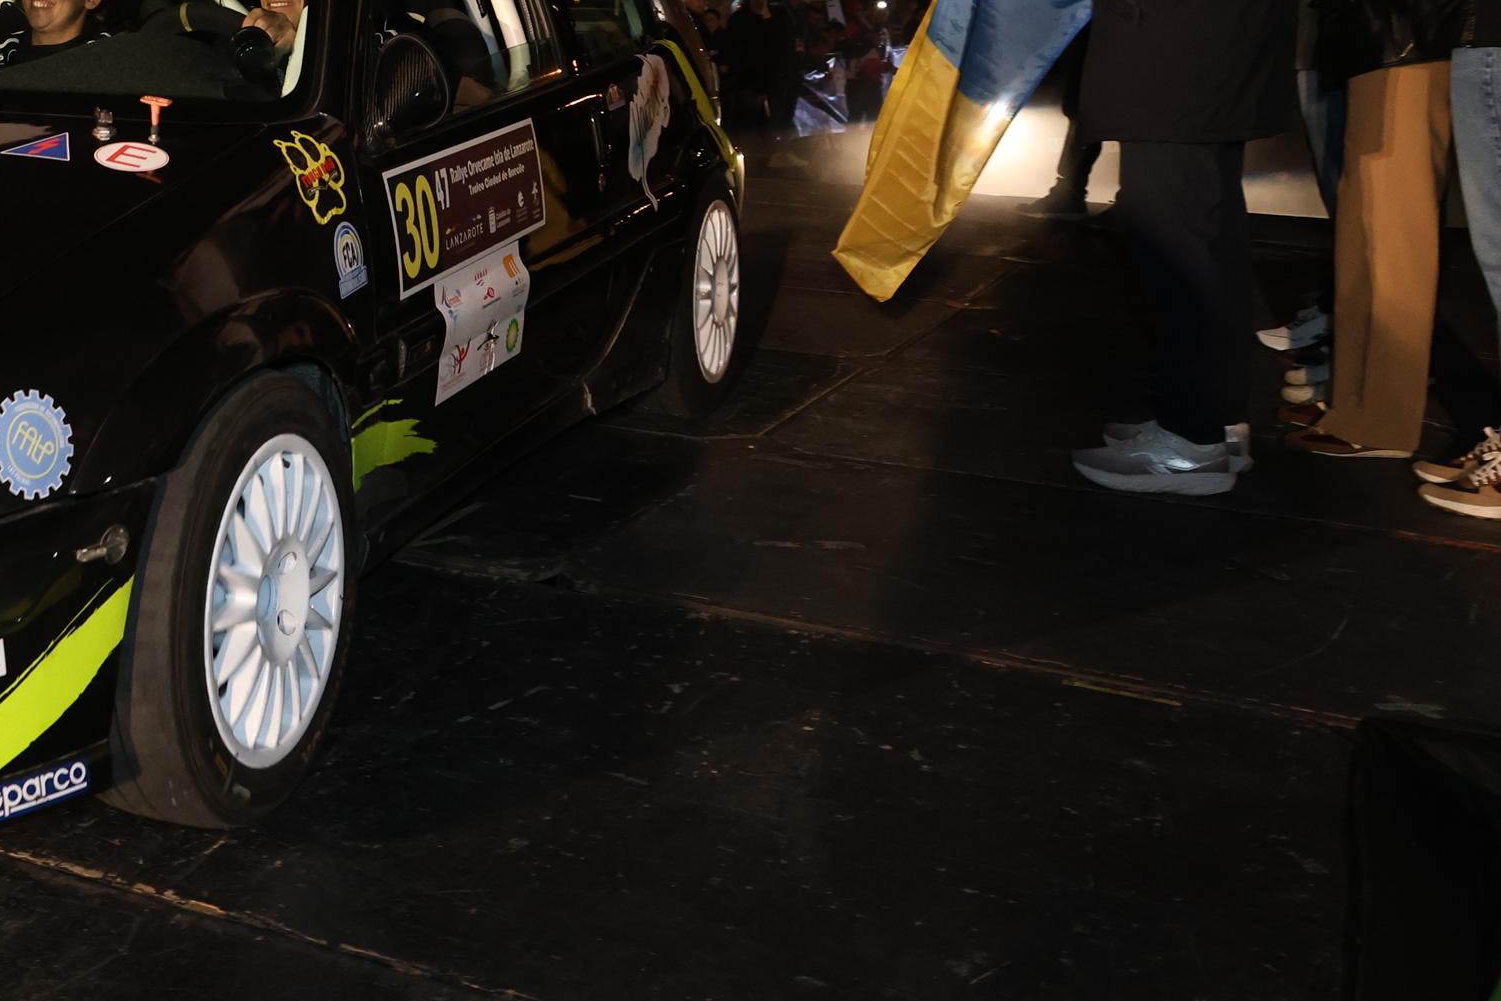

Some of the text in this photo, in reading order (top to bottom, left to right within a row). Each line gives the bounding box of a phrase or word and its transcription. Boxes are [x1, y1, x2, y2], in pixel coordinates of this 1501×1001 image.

[106, 144, 158, 168] E
[434, 166, 451, 211] 47
[394, 173, 440, 279] 30
[445, 221, 484, 250] LANZAROTE
